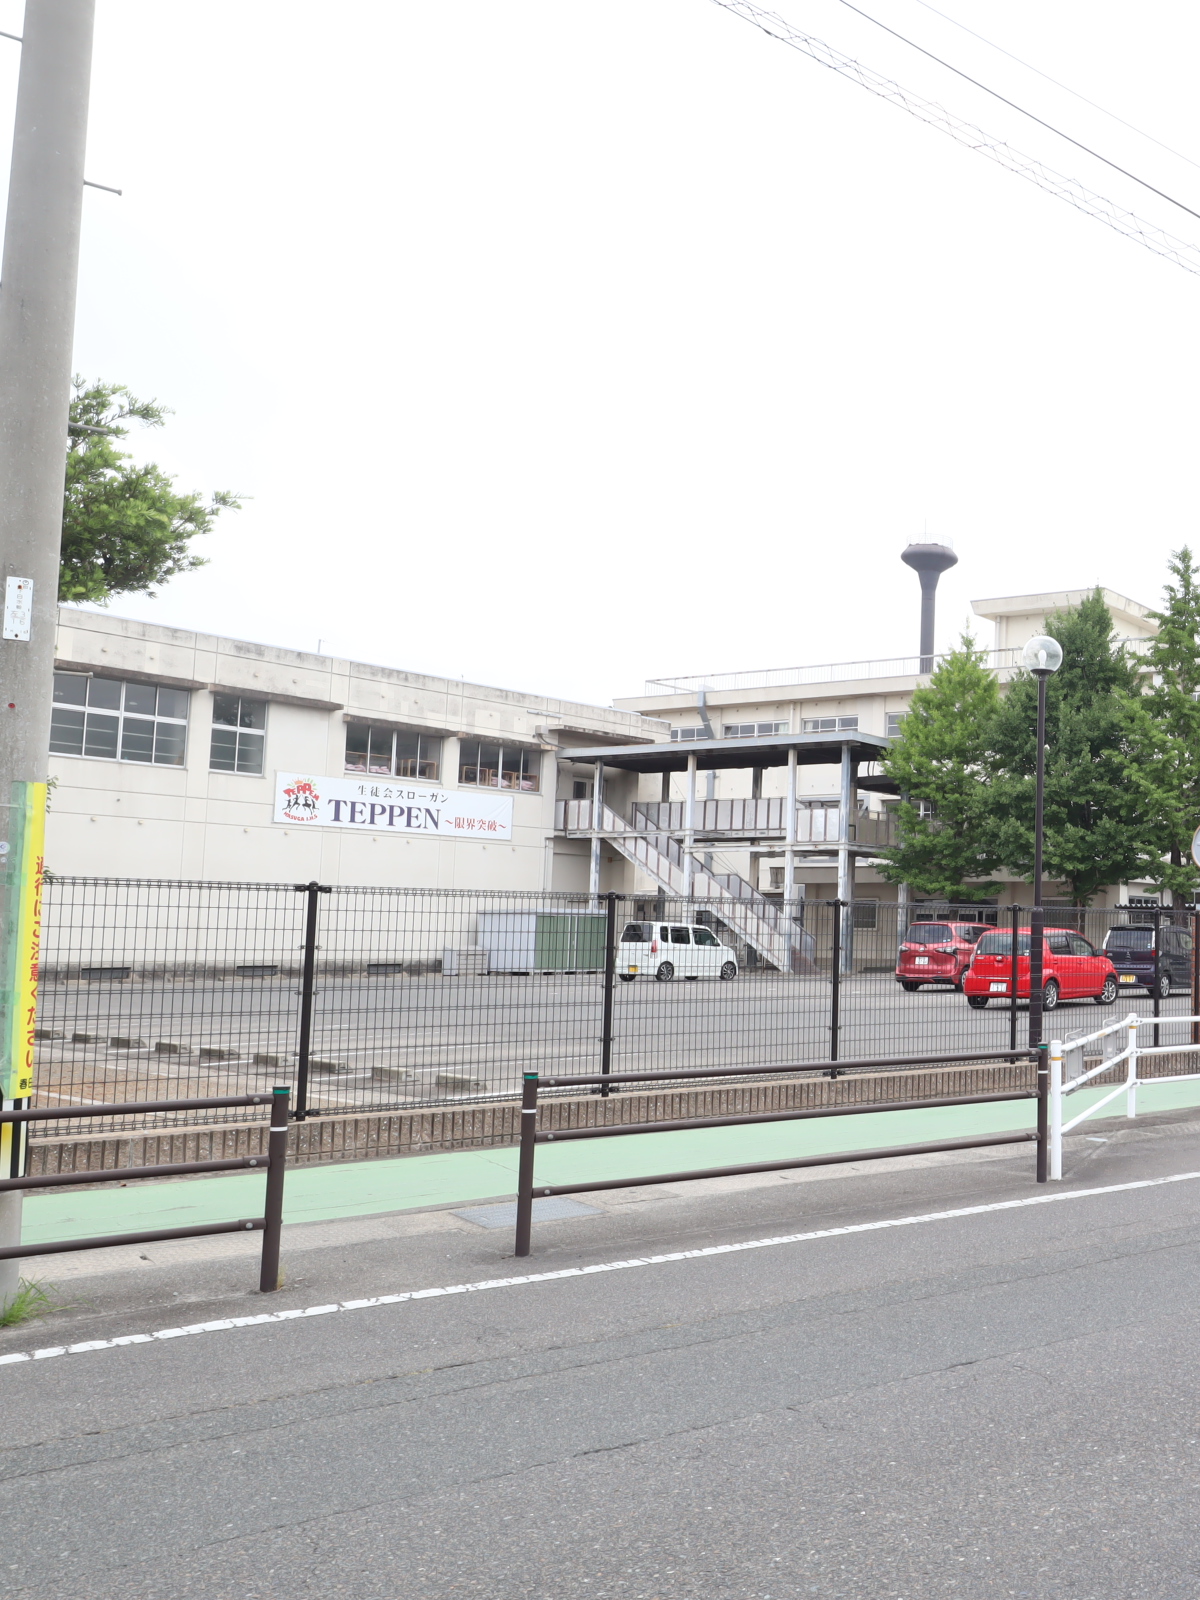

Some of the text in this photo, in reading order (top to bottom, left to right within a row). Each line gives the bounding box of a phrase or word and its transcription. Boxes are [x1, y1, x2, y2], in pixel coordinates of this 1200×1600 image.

[283, 783, 320, 801] TEPPEN
[357, 785, 448, 803] 生徒会スローガン
[327, 799, 441, 830] TEPPEN
